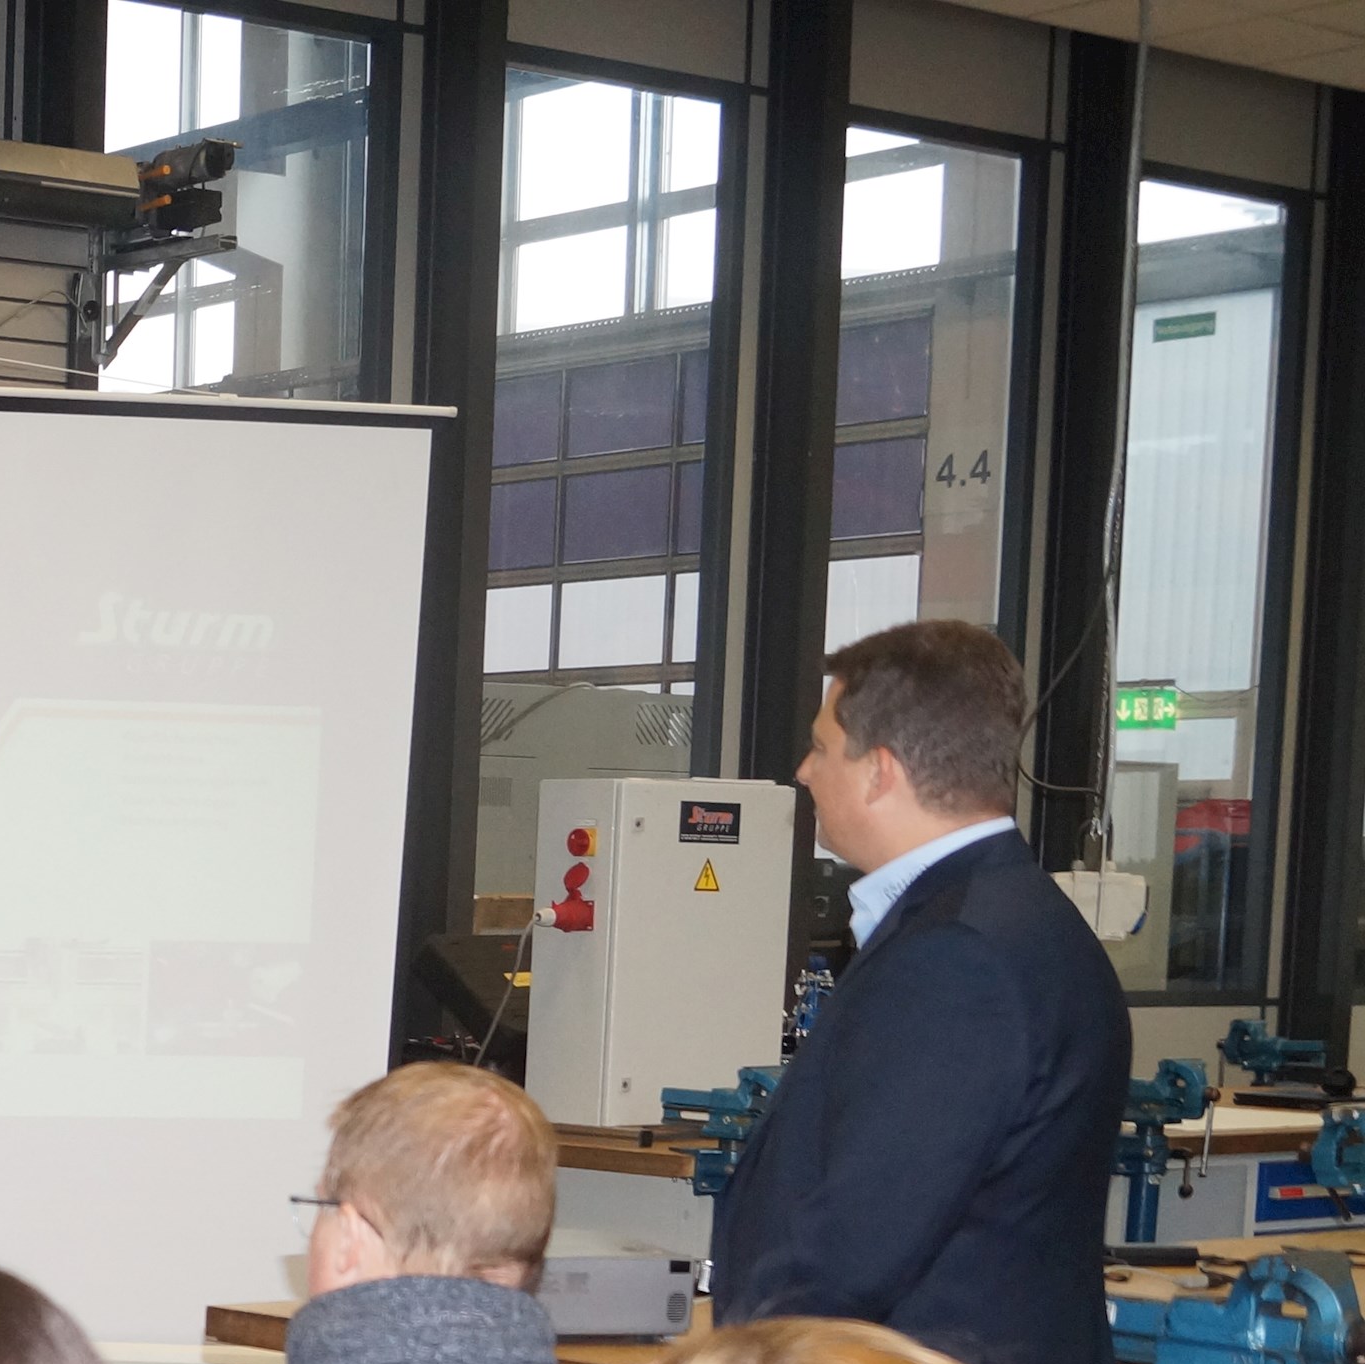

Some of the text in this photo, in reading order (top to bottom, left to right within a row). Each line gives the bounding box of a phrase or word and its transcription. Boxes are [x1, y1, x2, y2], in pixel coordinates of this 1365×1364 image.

[936, 449, 991, 488] 4.4
[77, 592, 275, 650] Sturm
[697, 824, 730, 833] GRUPPE
